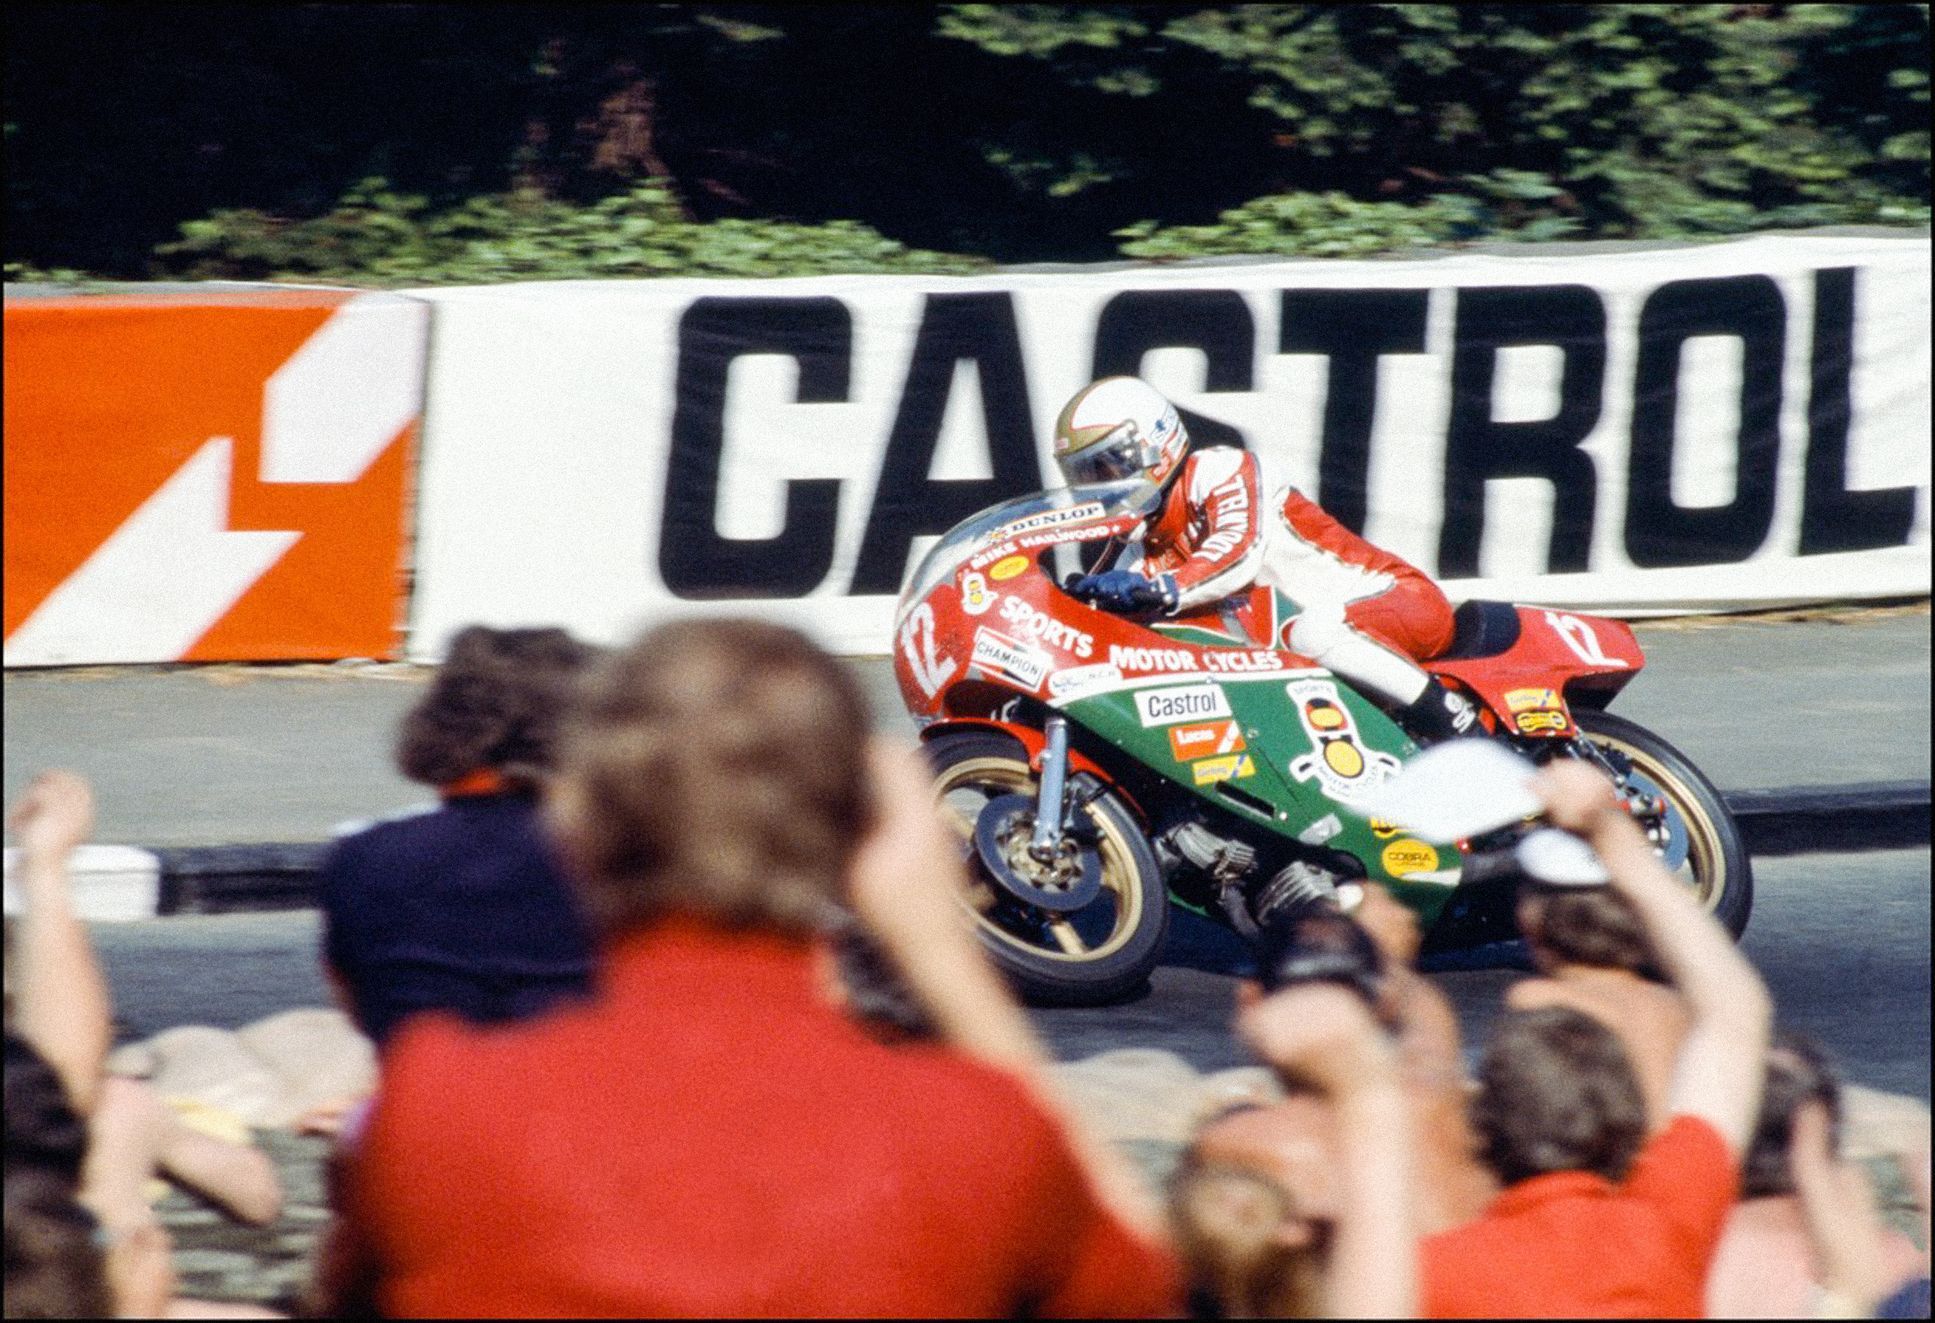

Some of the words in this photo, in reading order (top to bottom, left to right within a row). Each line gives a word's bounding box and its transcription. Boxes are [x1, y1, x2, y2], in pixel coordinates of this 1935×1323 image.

[1012, 505, 1099, 532] DUNLOP
[970, 540, 1019, 570] MIKE
[1019, 524, 1111, 548] HAILWOOD
[900, 602, 959, 700] 12
[998, 595, 1094, 659] SPORTS
[1108, 644, 1199, 672] MOTOR
[1203, 650, 1284, 672] CYCLES
[1543, 610, 1630, 667] 12
[976, 641, 1040, 676] CHAMPION
[1147, 690, 1218, 719] Castrol
[1175, 728, 1216, 746] Lucas
[1388, 851, 1432, 861] COBRA
